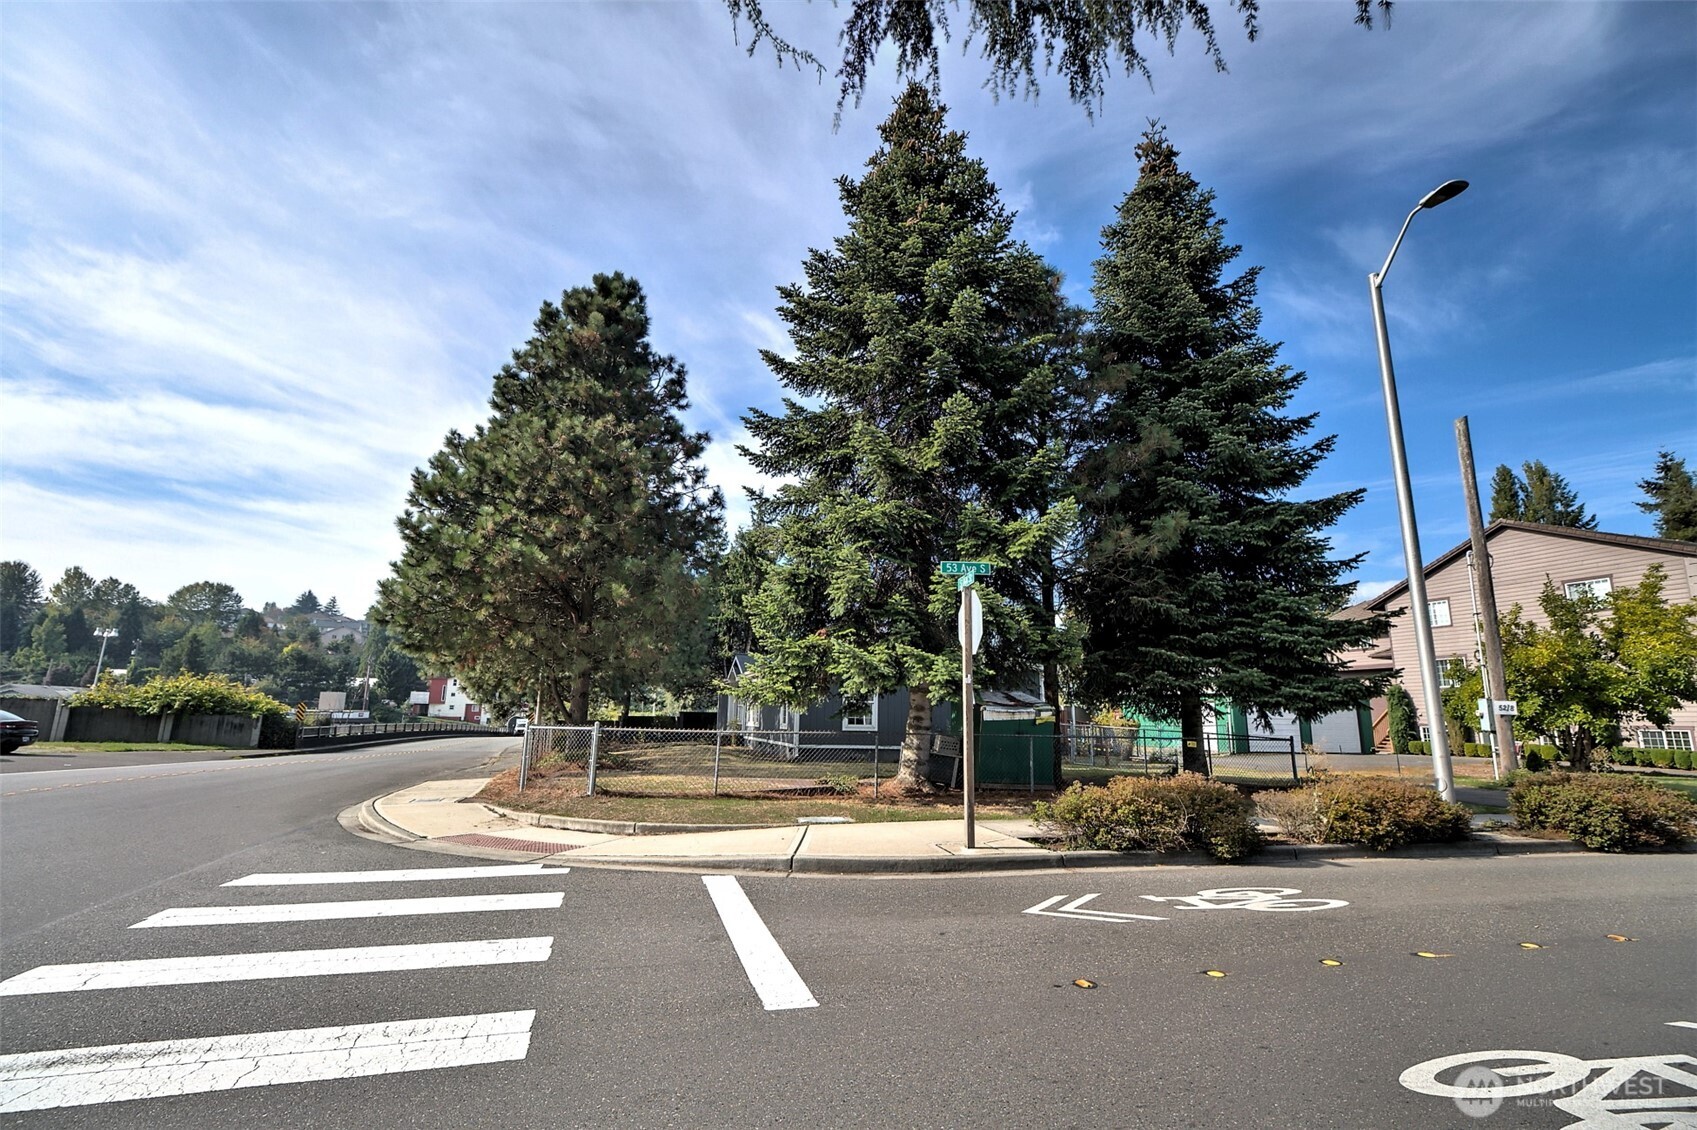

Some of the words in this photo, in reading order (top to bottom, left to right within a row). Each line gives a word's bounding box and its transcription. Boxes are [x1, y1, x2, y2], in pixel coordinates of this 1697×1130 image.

[946, 563, 958, 573] 53
[960, 563, 977, 573] Ave
[980, 564, 986, 573] S
